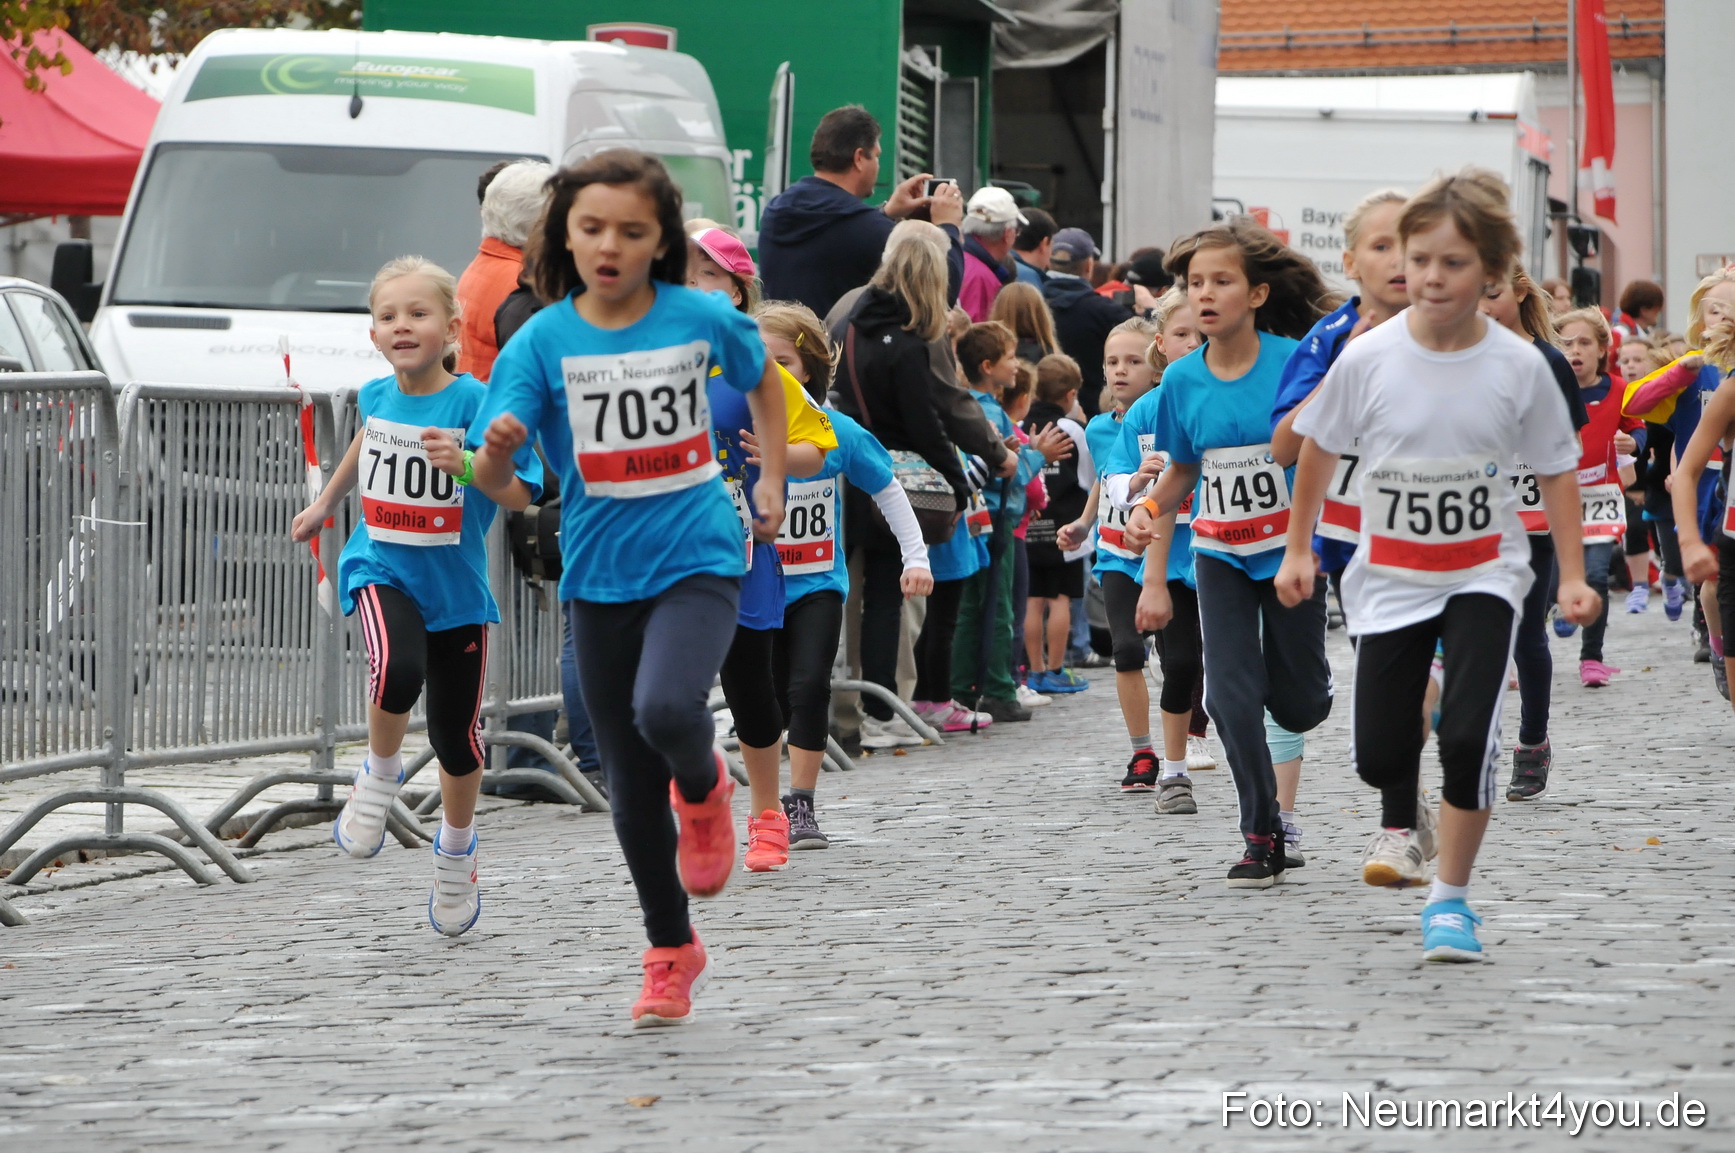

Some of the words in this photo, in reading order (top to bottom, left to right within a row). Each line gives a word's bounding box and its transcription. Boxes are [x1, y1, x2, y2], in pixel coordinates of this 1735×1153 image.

[351, 61, 460, 77] Europcar
[334, 77, 392, 89] moving
[396, 79, 431, 89] your
[434, 82, 469, 93] way
[567, 370, 619, 384] PARTL
[623, 360, 693, 380] Neumarkt
[583, 378, 697, 443] 7031
[366, 428, 388, 444] PARTL
[390, 434, 426, 451] Neuma
[367, 448, 454, 501] 7100
[625, 451, 681, 476] Alicia
[1212, 457, 1260, 470] Neumarkt
[1412, 469, 1480, 484] Neumarkt
[787, 491, 819, 501] umarkt
[375, 505, 427, 529] Sophia
[778, 503, 826, 539] 08
[1378, 485, 1491, 536] 7568
[779, 548, 803, 563] atja
